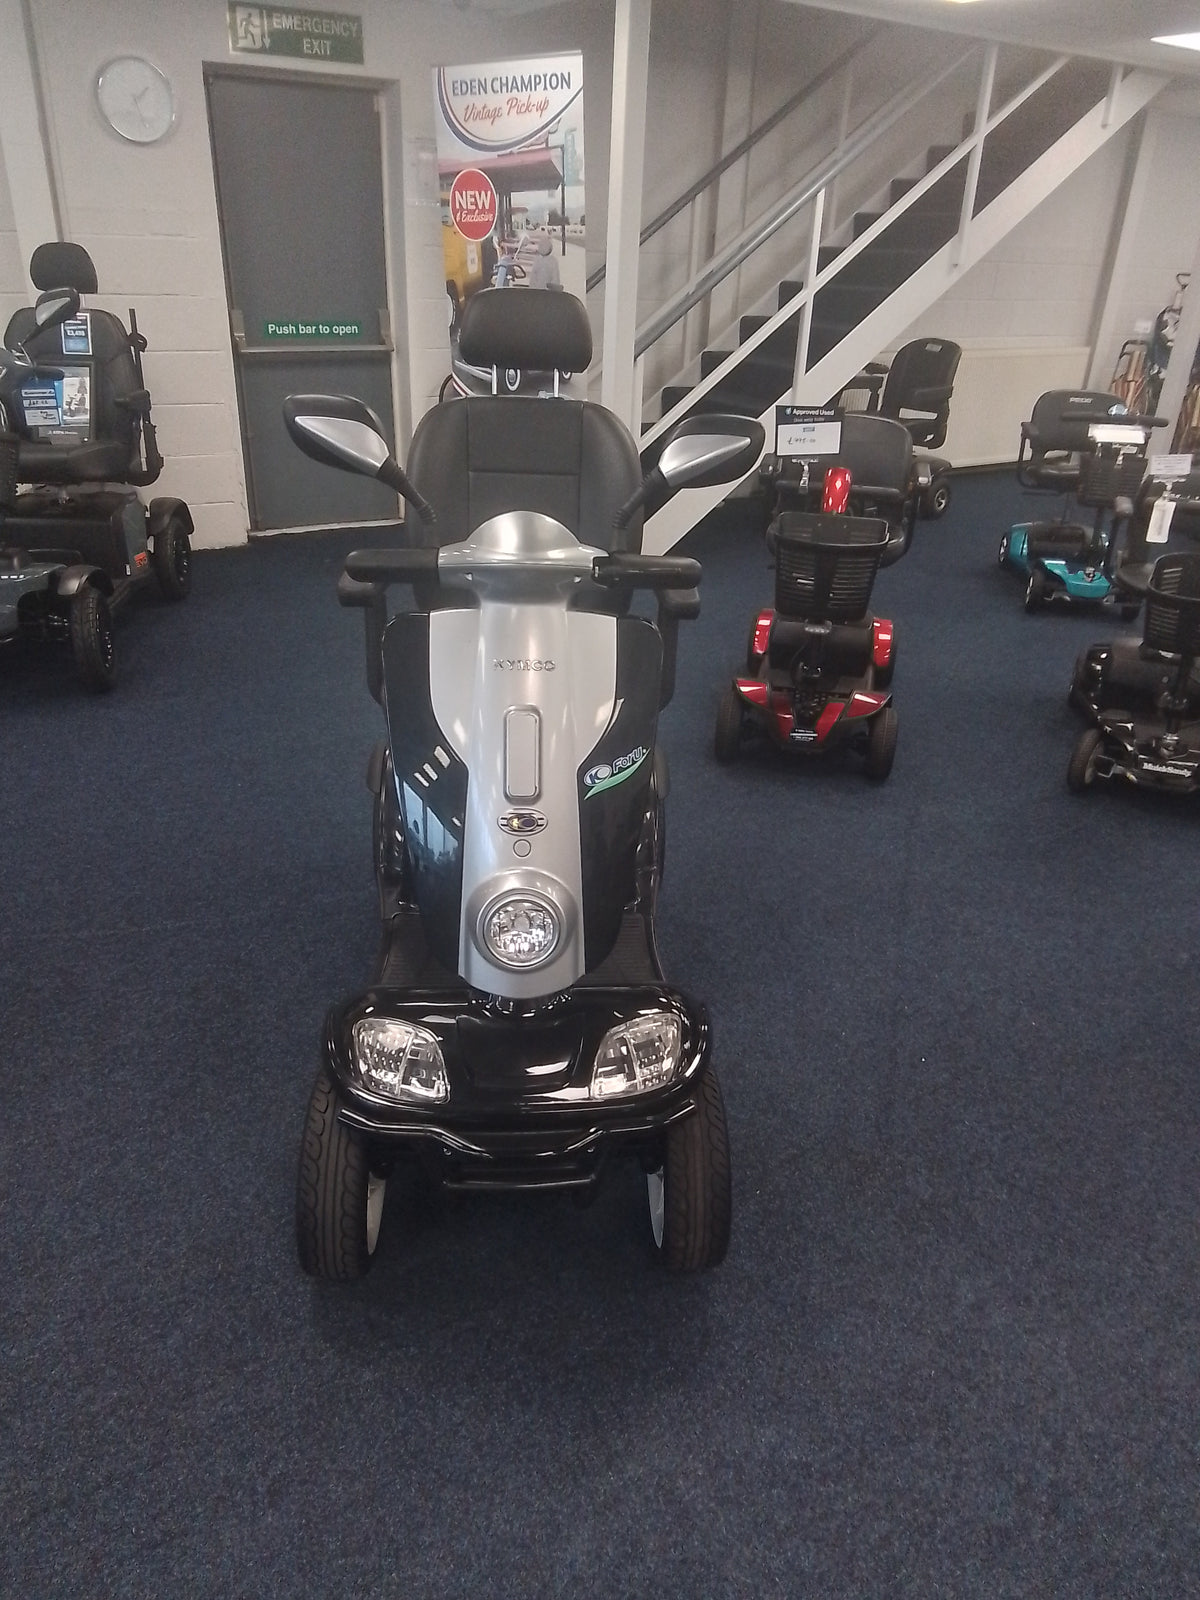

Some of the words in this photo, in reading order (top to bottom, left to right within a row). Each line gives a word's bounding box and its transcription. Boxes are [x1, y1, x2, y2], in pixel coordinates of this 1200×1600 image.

[272, 12, 358, 37] EMERGENCY
[303, 38, 332, 55] EXIT
[452, 78, 488, 96] EDEN
[491, 72, 571, 94] CHAMPION
[463, 103, 503, 126] Vintage
[506, 94, 549, 118] Pick-up
[454, 190, 492, 210] NEW
[461, 209, 494, 223] Exclusive
[268, 323, 297, 334] Push
[298, 323, 317, 334] bar
[319, 324, 330, 334] to
[332, 325, 359, 336] open
[793, 408, 819, 416] Approved
[492, 659, 556, 671] KYMCO
